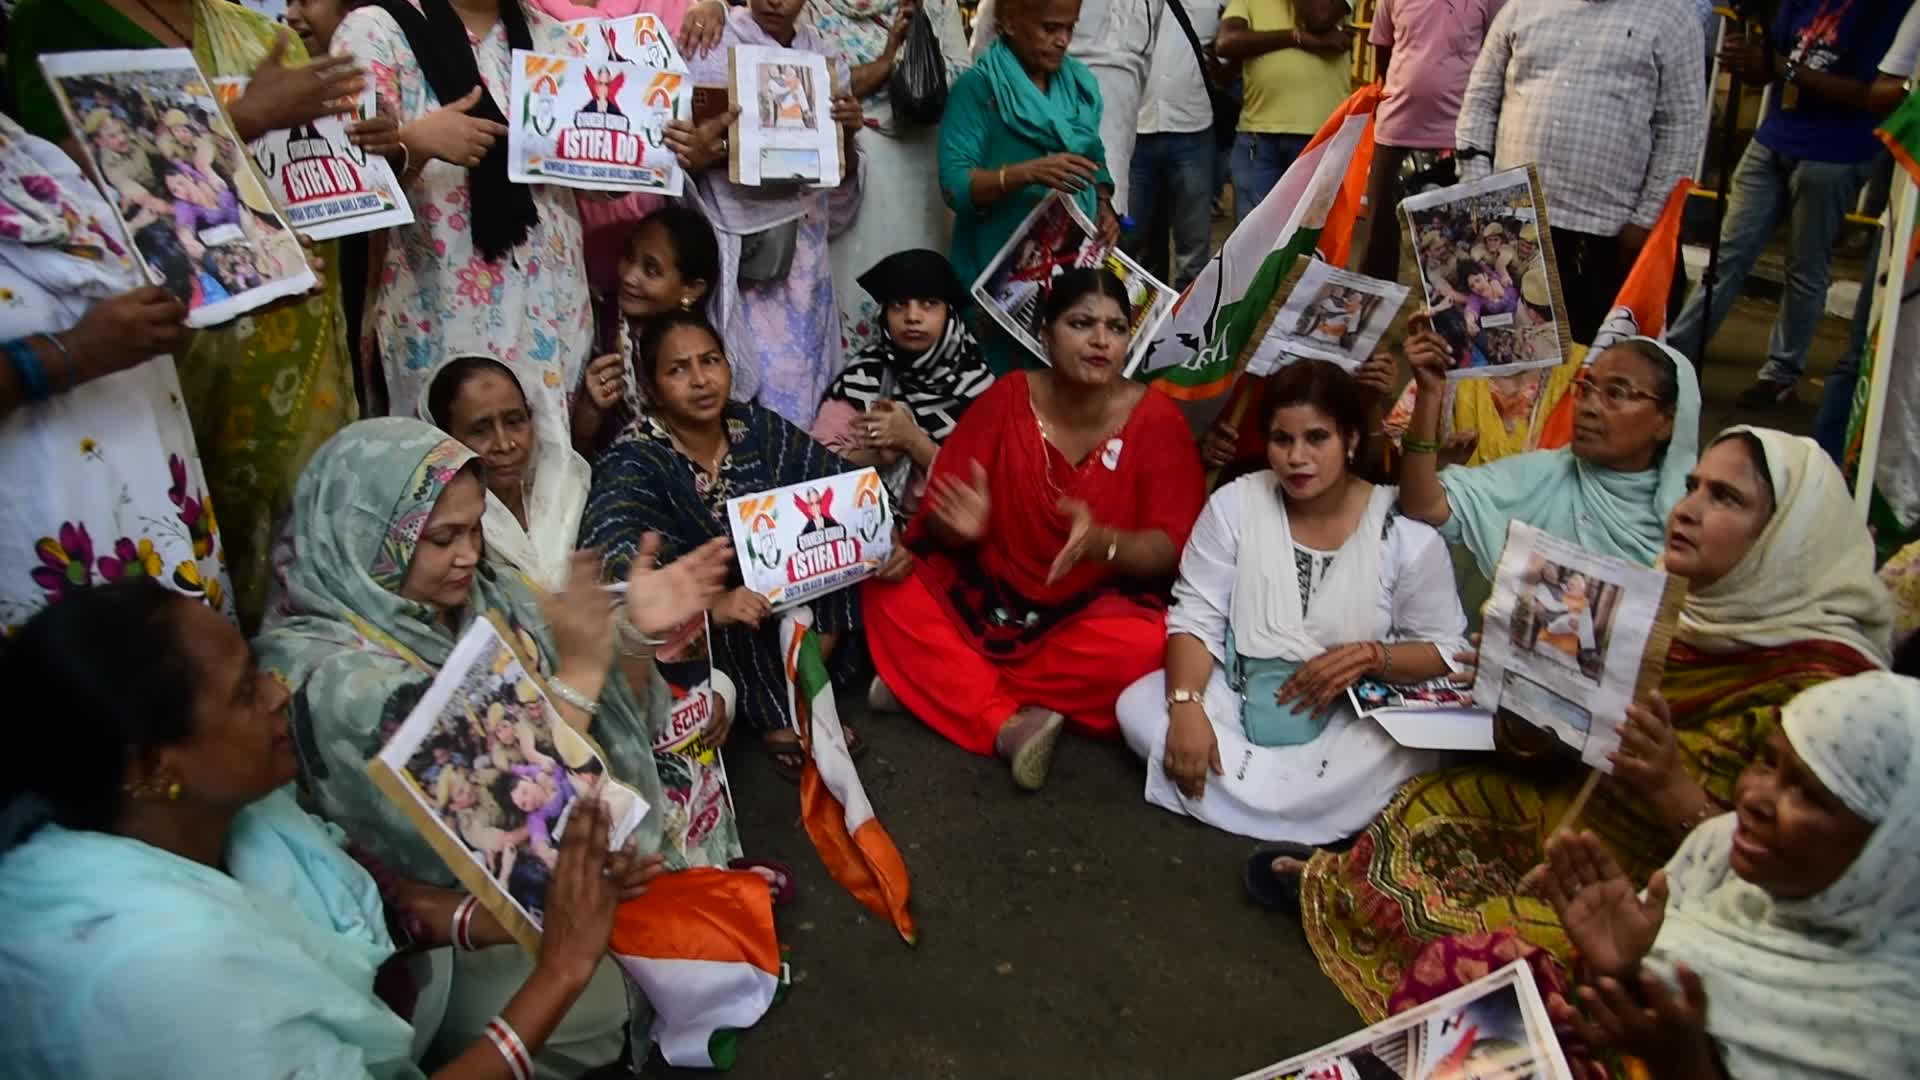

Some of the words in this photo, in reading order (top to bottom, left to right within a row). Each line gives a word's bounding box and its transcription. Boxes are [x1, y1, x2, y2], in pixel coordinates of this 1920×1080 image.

[563, 129, 613, 161] ISTIFA
[615, 131, 638, 165] DO
[285, 159, 336, 201] ISTIFA
[327, 157, 357, 193] DO
[791, 542, 837, 580] ISTIFA
[836, 539, 857, 566] DO
[672, 691, 709, 736] हटाओ
